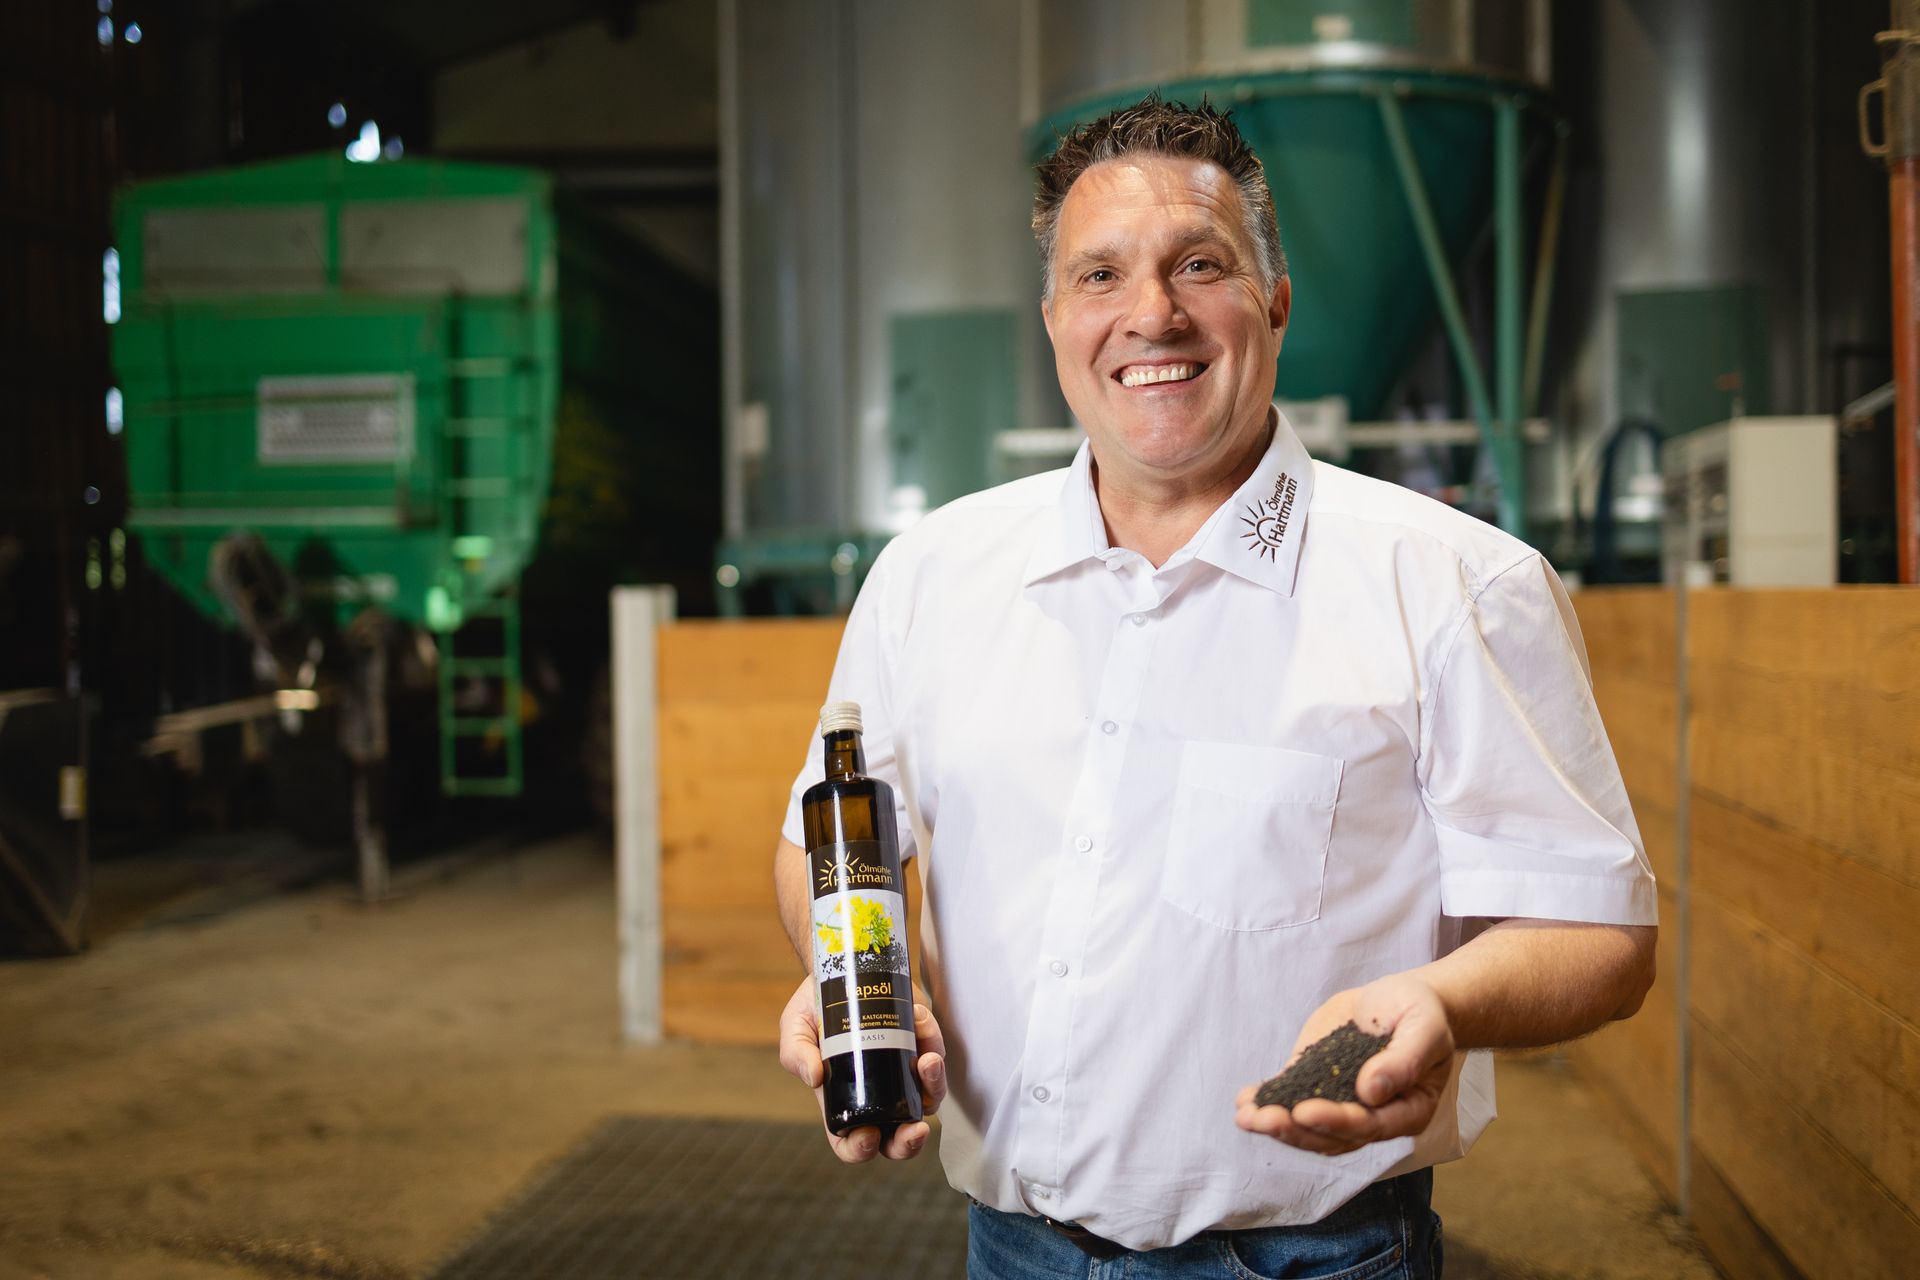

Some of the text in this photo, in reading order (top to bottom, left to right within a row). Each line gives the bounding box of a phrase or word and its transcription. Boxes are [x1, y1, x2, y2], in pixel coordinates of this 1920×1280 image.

[1265, 472, 1287, 510] Ölmühle
[1268, 477, 1297, 543] Hartmann
[858, 863, 891, 874] Ölmühle
[846, 982, 892, 998] apsöl
